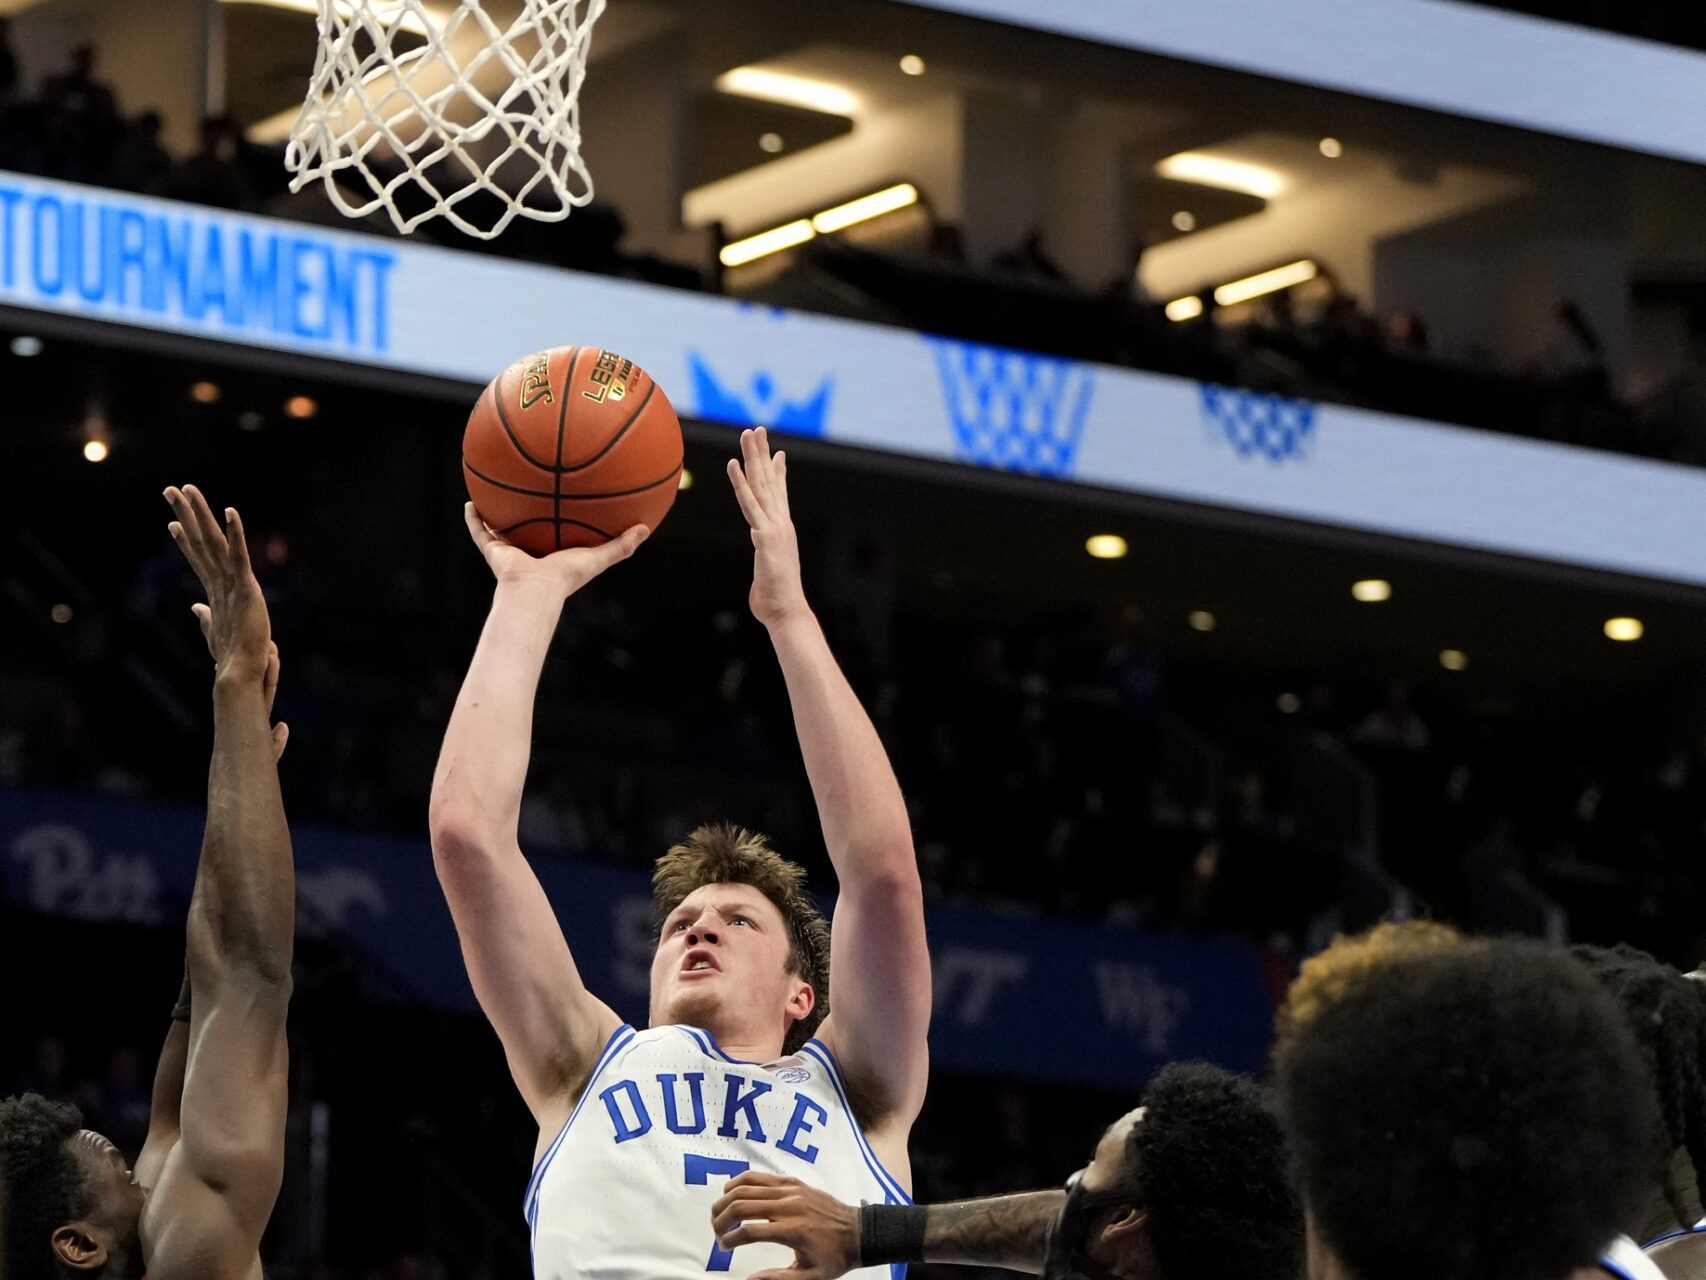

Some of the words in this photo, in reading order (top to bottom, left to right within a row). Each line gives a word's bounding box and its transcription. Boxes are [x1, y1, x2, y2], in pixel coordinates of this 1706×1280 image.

[0, 187, 398, 351] TOURNAMENT
[598, 1072, 828, 1165] DUKE
[683, 1152, 751, 1272] 7
